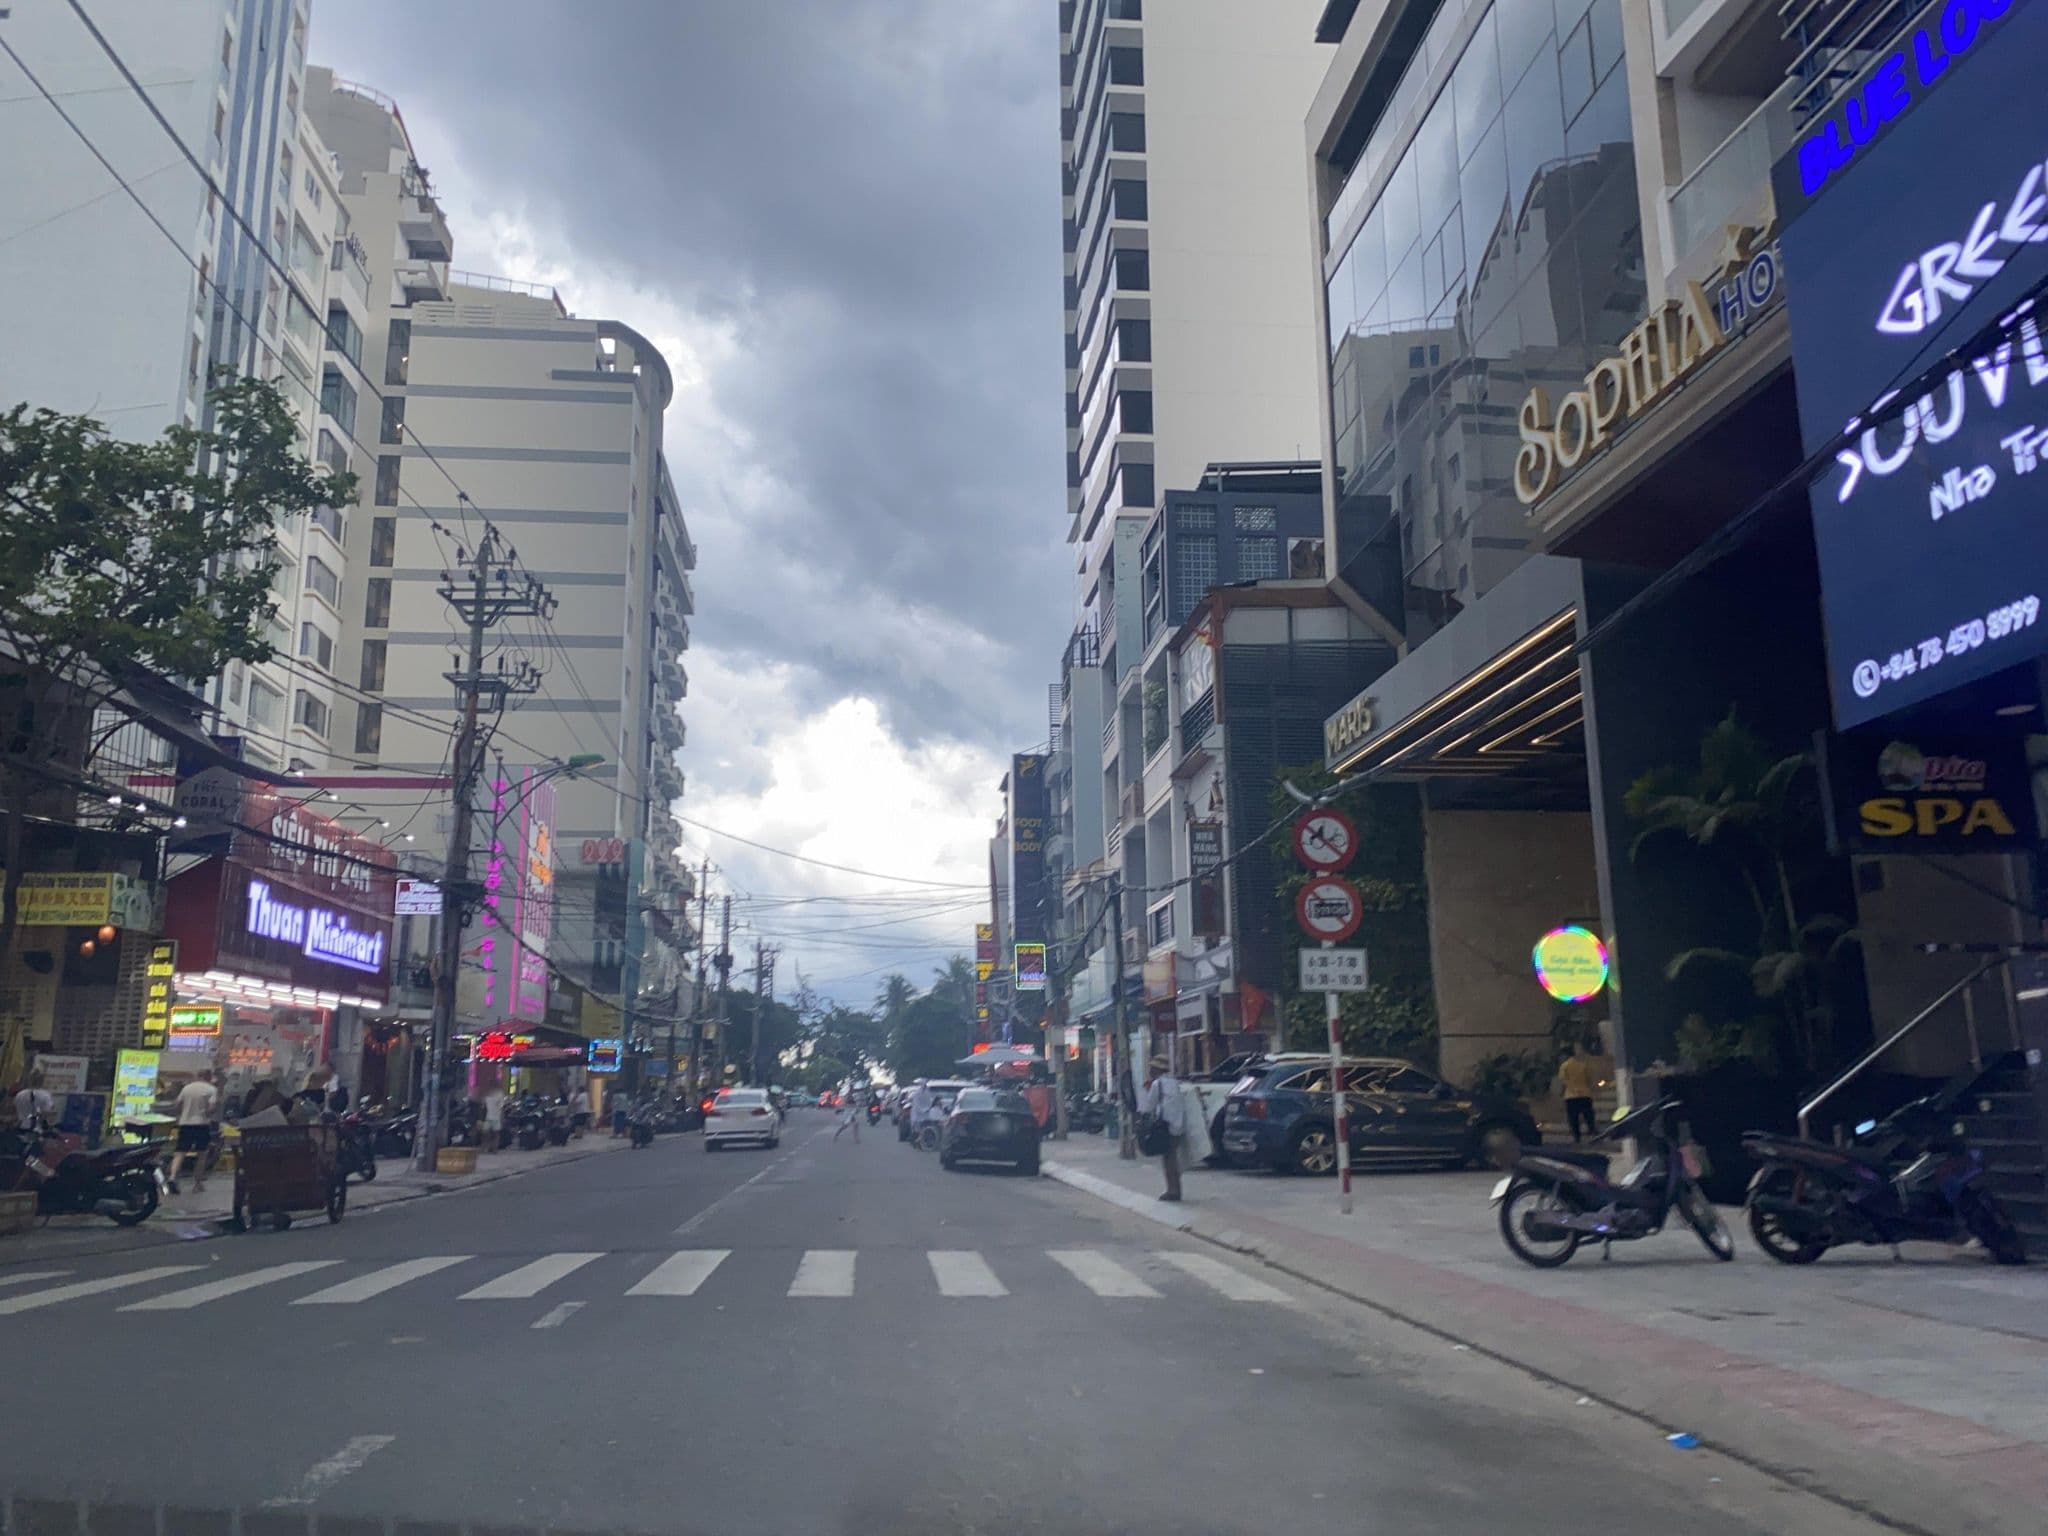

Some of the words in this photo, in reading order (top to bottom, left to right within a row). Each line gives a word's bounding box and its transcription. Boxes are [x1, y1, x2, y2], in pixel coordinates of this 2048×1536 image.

[1798, 52, 1911, 195] BLUE
[1718, 237, 1783, 335] HO
[1859, 797, 2016, 836] SPA
[304, 907, 384, 970] Minimart
